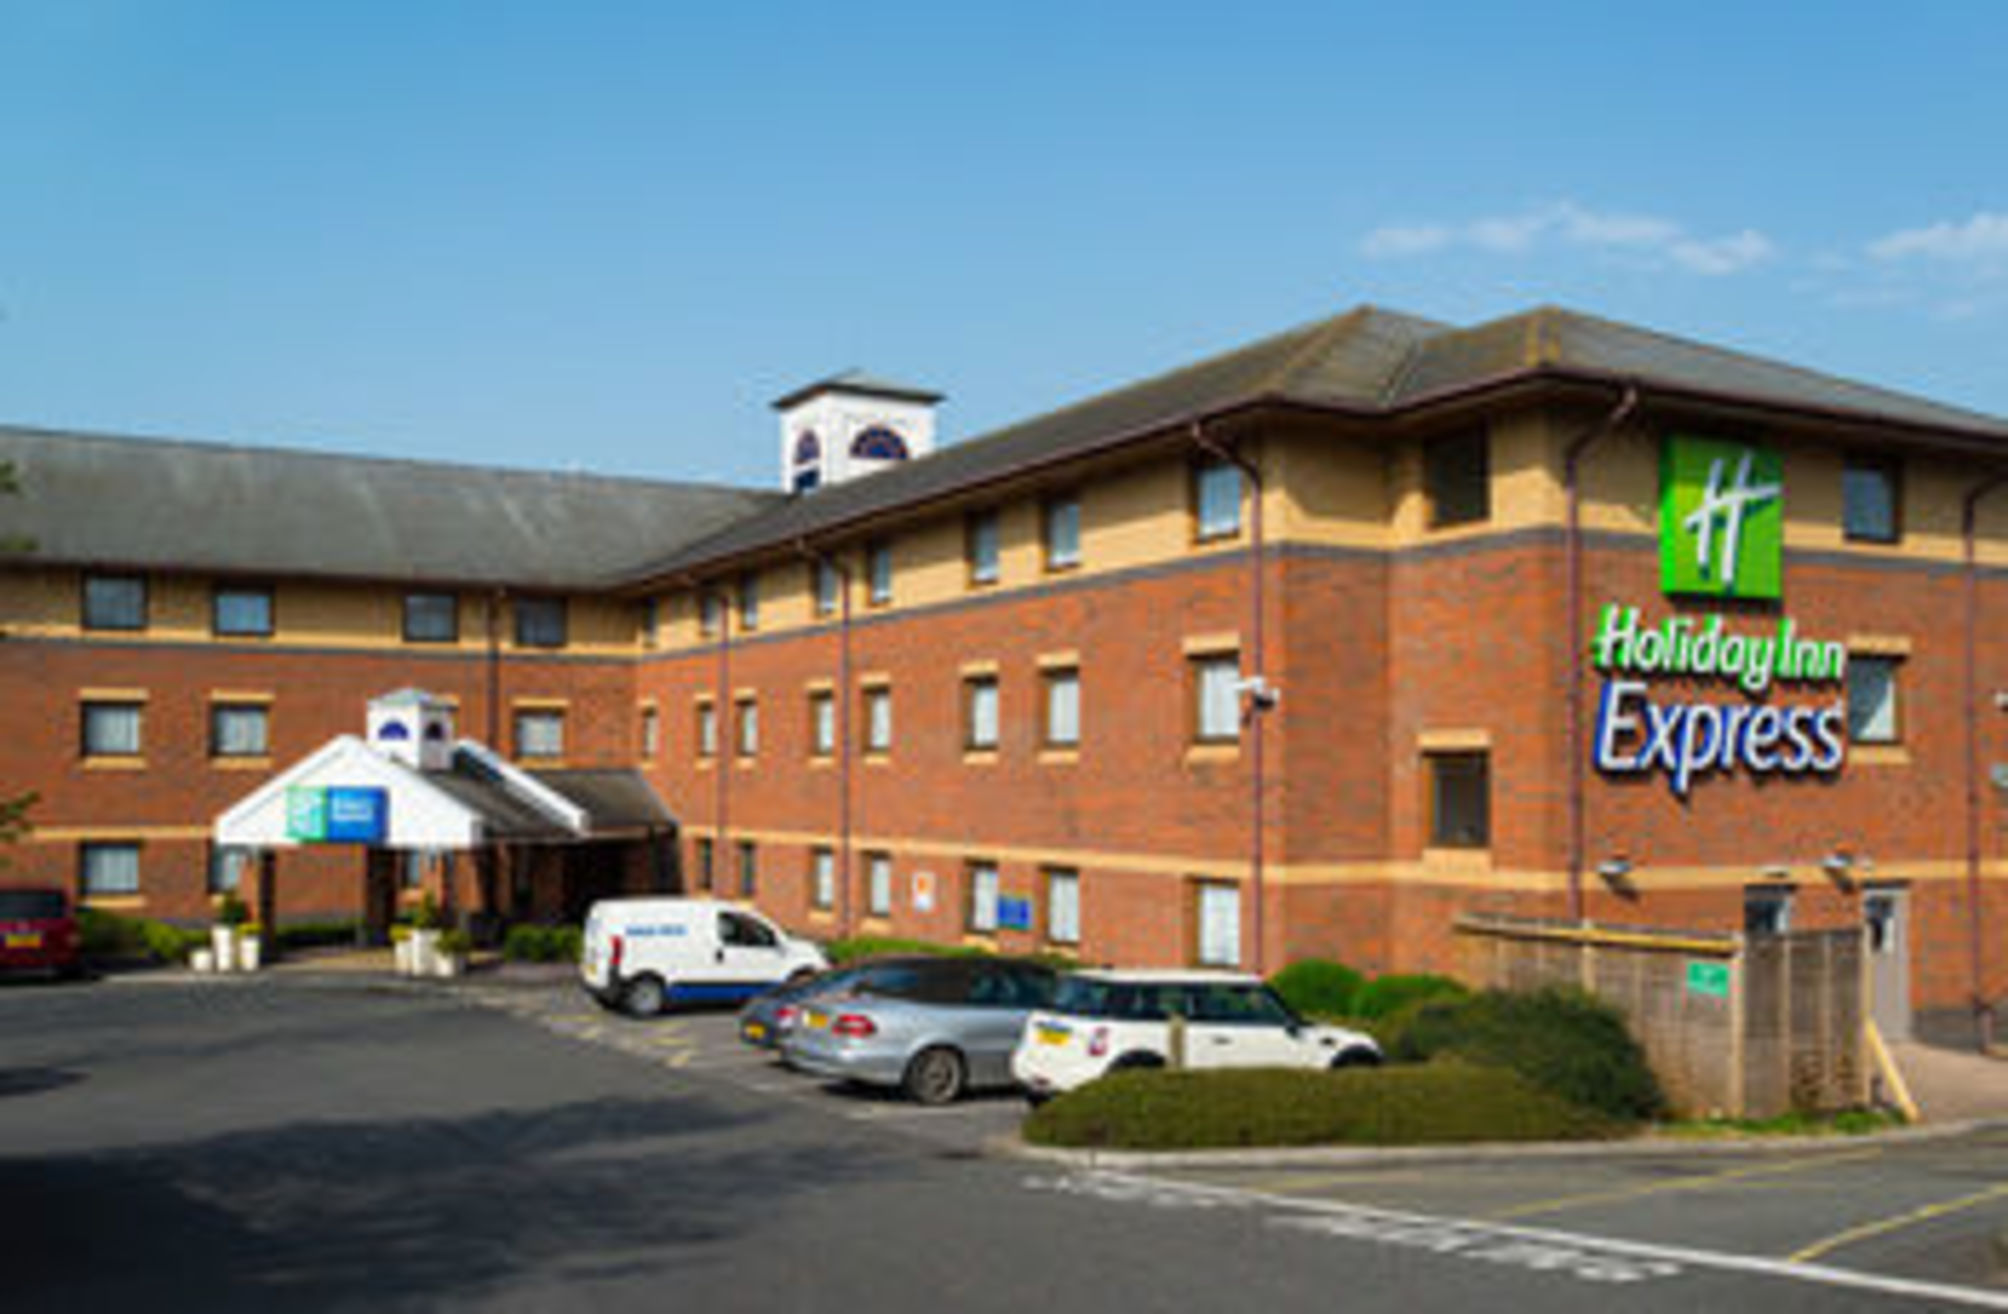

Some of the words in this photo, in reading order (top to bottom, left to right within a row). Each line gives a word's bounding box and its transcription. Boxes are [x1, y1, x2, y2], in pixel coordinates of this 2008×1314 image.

[1594, 603, 1774, 690] Holiday
[1774, 616, 1843, 678] Inn
[1594, 680, 1843, 794] Express
